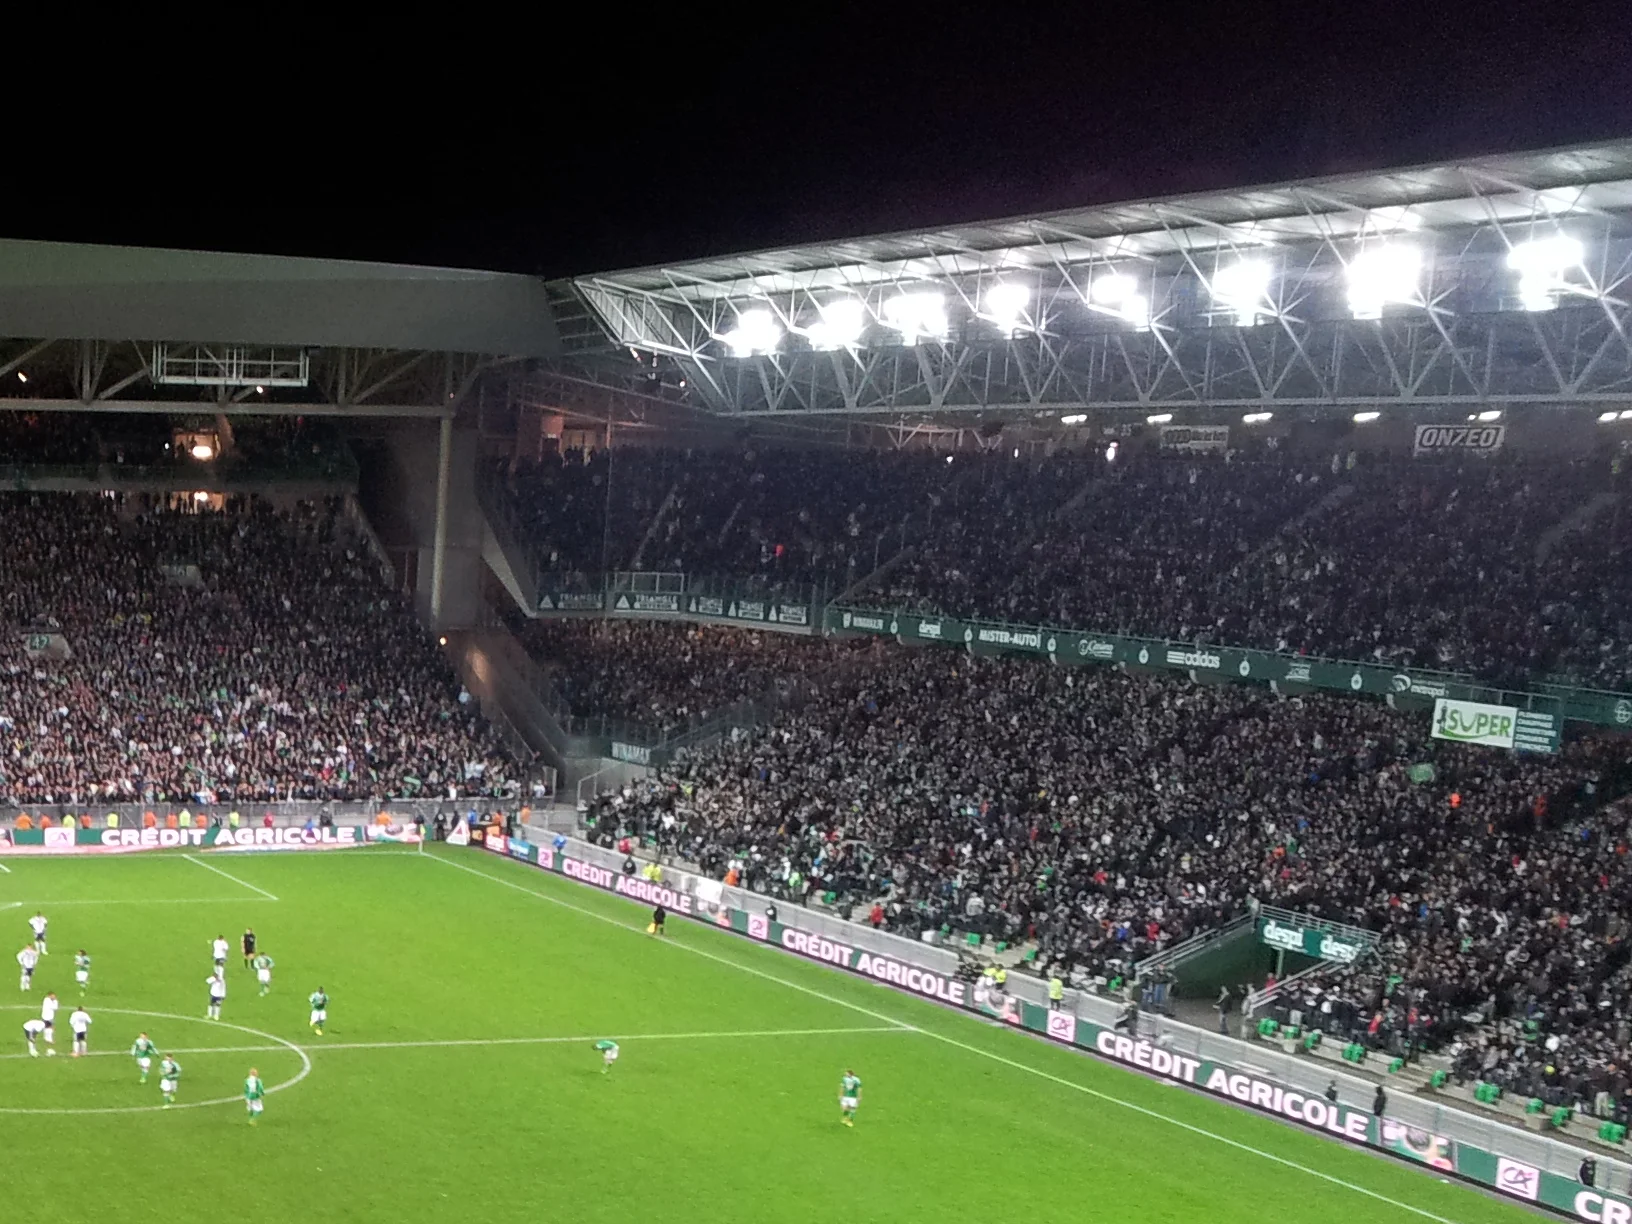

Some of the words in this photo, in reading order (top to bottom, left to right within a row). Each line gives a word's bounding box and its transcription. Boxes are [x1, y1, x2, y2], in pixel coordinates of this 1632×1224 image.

[1422, 427, 1497, 447] ONZEO
[1184, 650, 1220, 668] adidas
[1448, 709, 1512, 737] SUPER
[101, 825, 207, 846] CRÉDIT
[214, 826, 355, 845] AGRICOLE
[562, 856, 614, 888] CRÉDIT
[616, 874, 692, 914] AGRICOLE
[781, 927, 854, 968] CRÉDIT
[855, 951, 965, 1005] AGRICOLE
[1096, 1029, 1203, 1083] CRÉDIT
[1206, 1066, 1369, 1141] AGRICOLE
